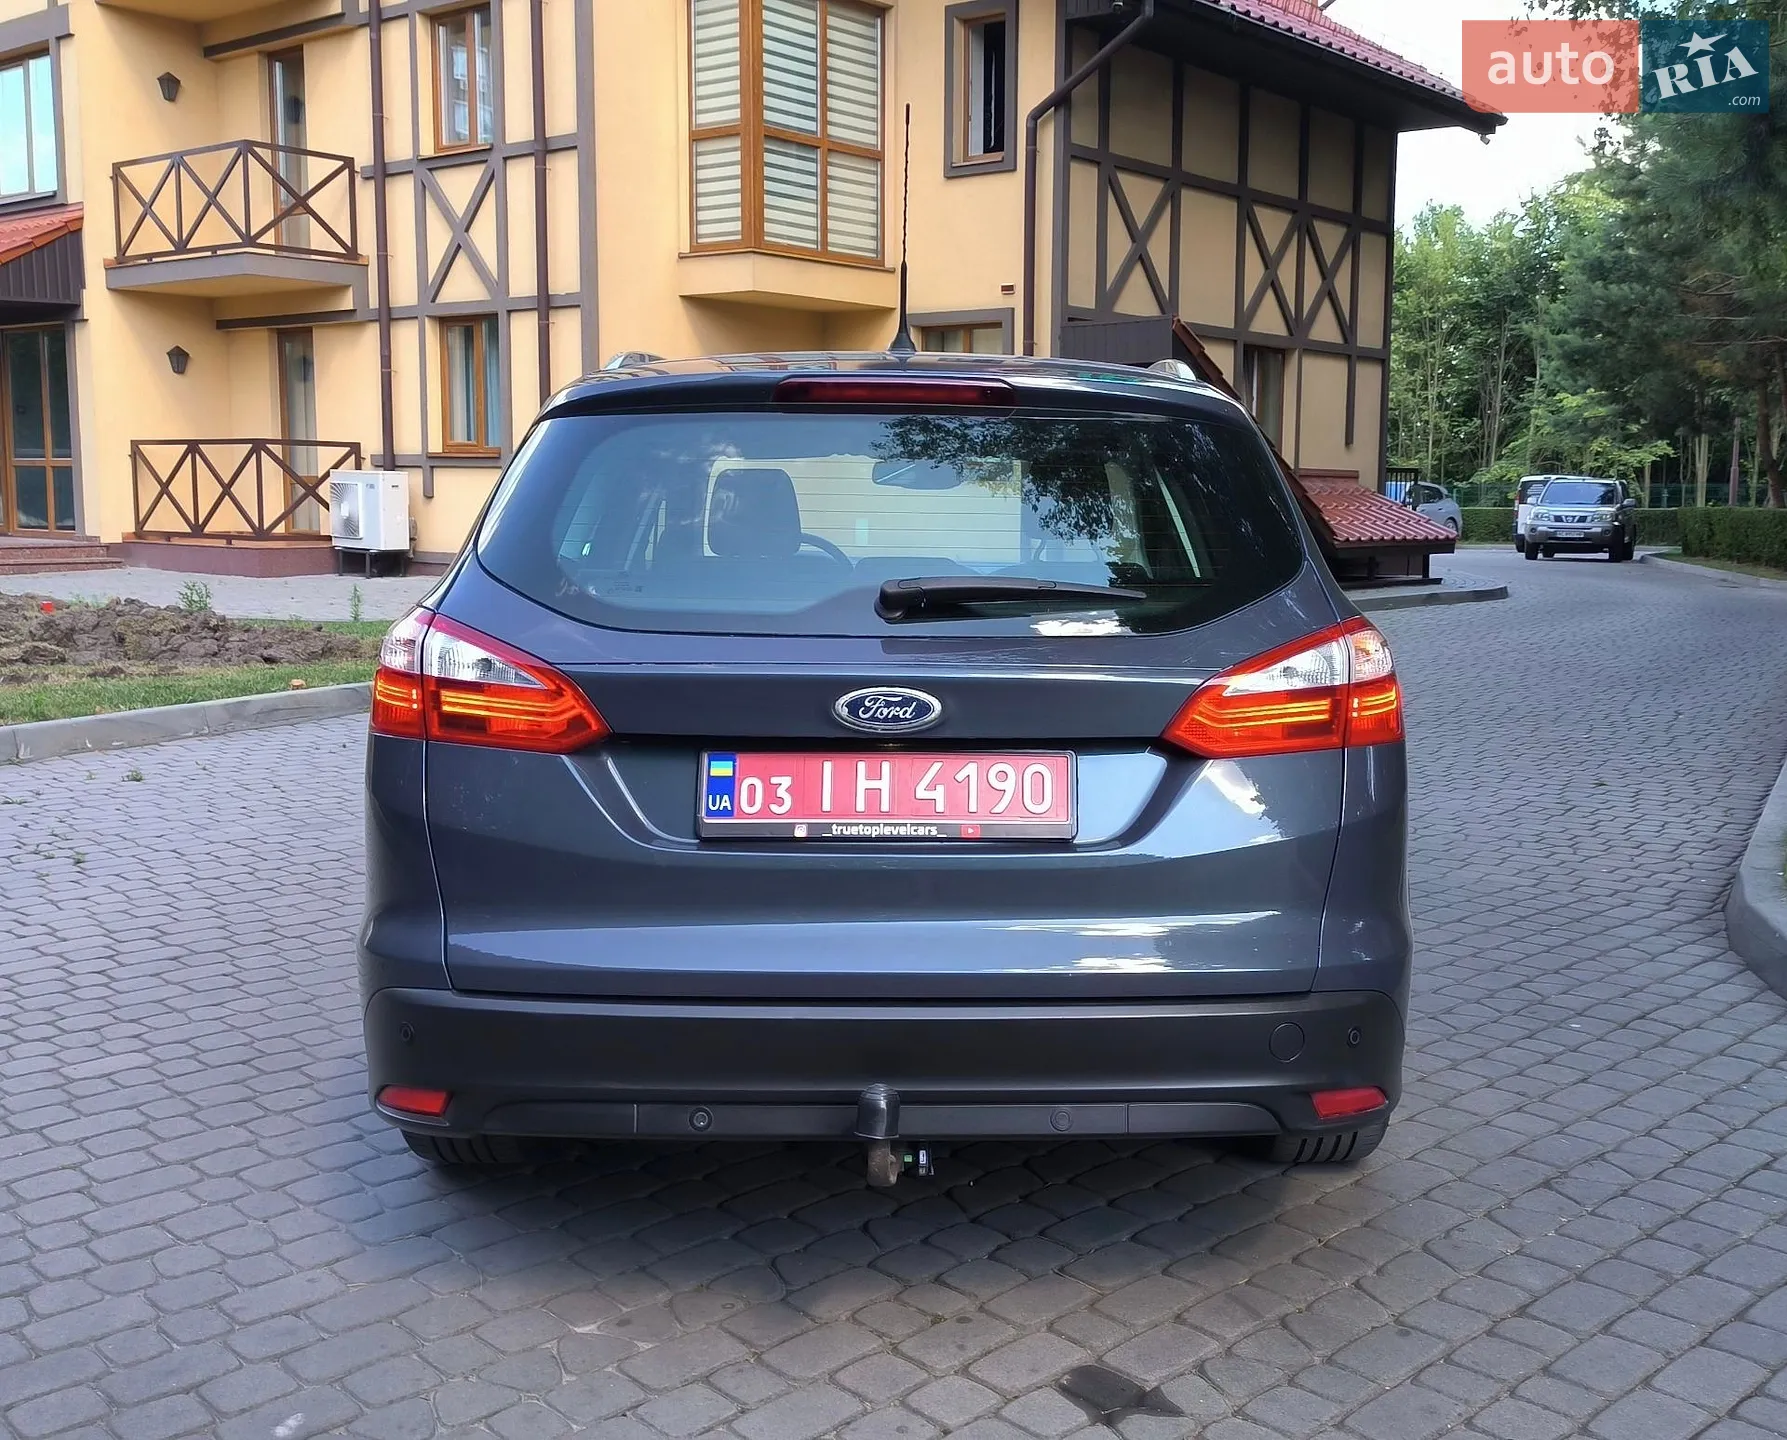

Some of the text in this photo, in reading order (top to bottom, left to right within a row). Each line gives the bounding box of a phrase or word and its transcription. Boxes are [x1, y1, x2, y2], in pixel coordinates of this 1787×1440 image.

[858, 695, 917, 720] Ford
[739, 760, 1054, 815] 03 IH 4190
[708, 794, 732, 811] UA
